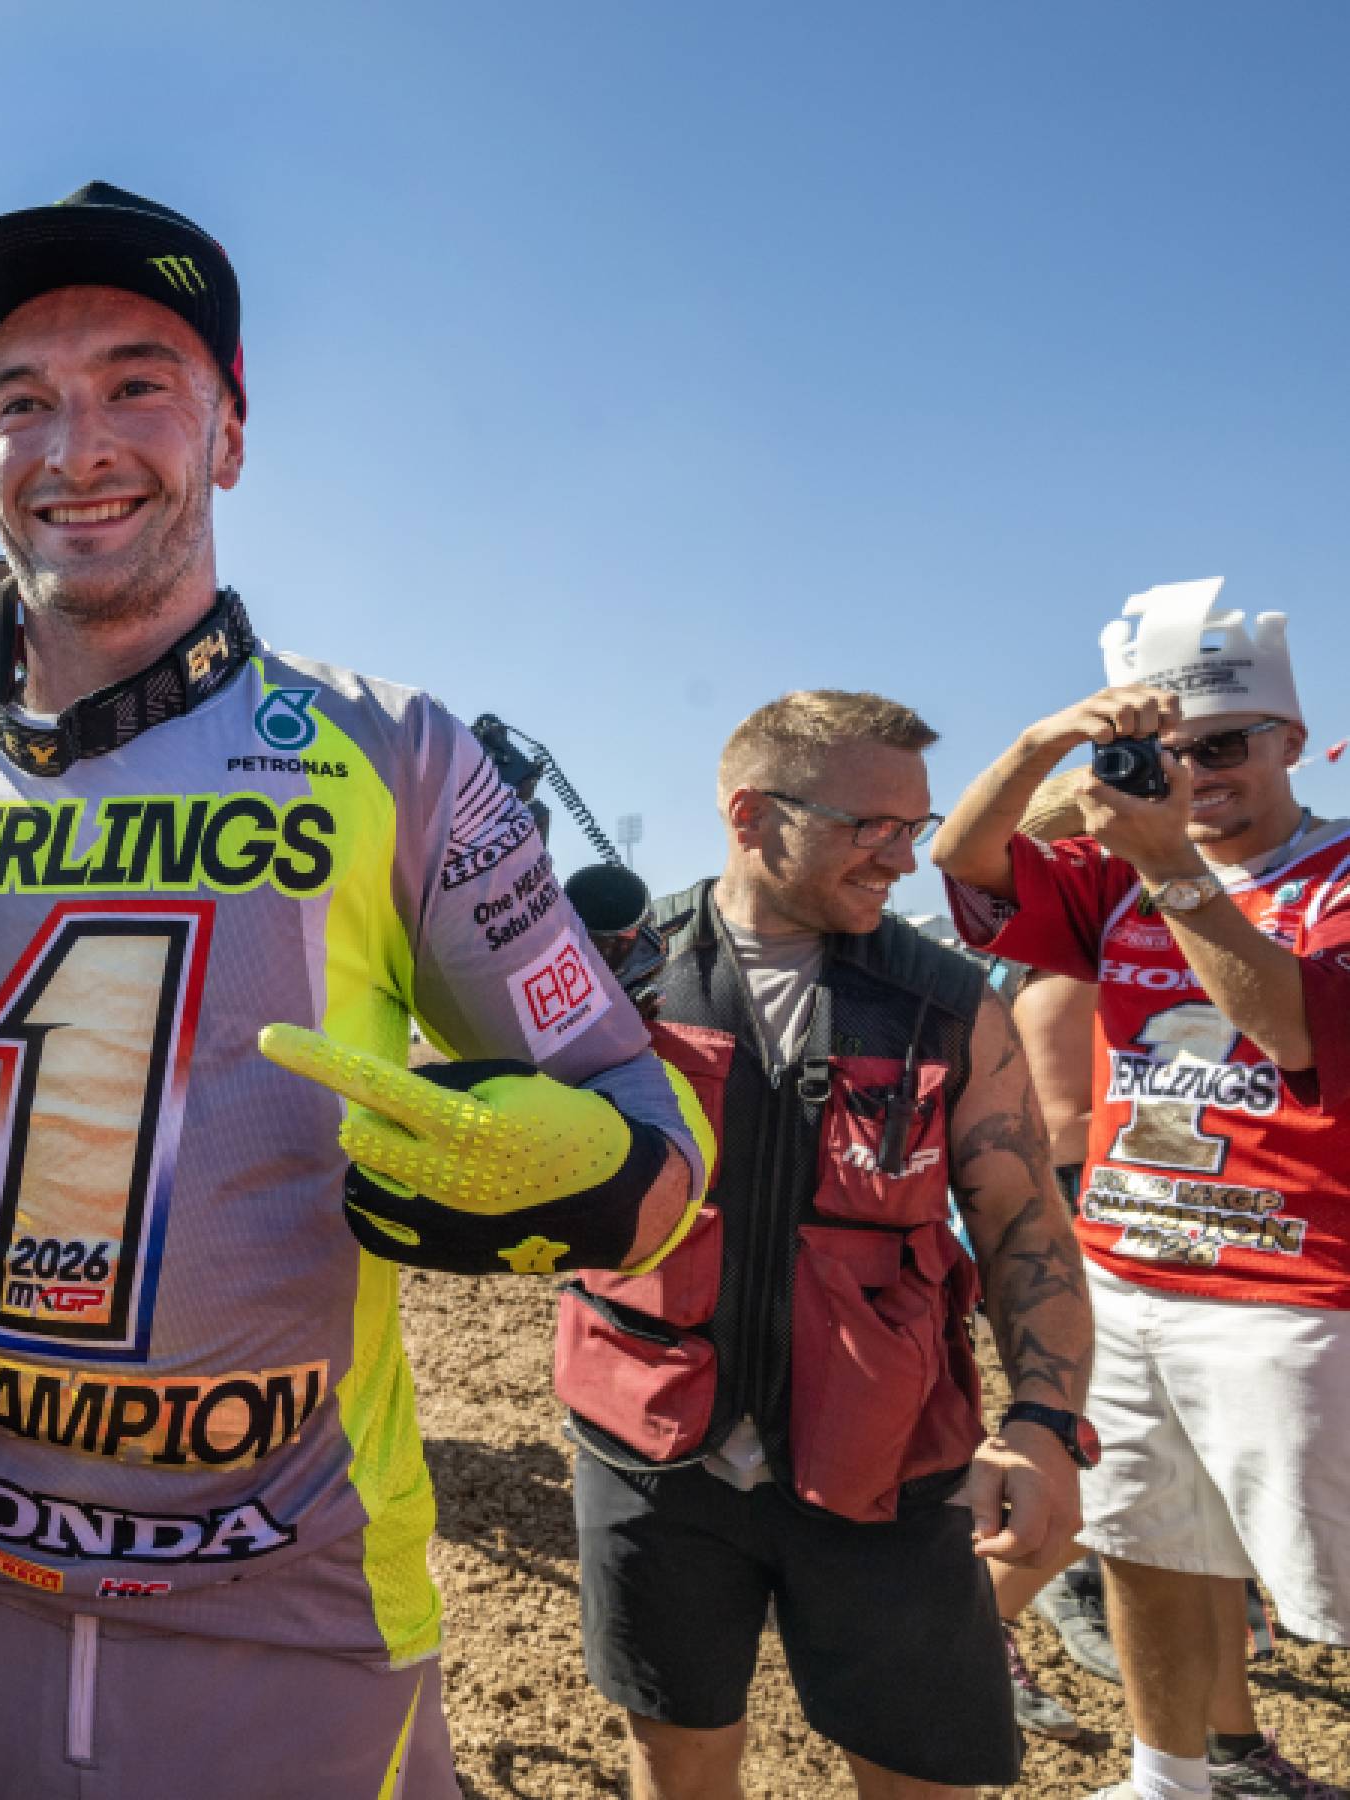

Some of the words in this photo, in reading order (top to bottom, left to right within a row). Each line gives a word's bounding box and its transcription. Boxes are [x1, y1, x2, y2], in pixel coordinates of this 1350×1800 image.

[226, 755, 348, 777] PETRONAS
[474, 889, 514, 926] One
[485, 909, 530, 952] Satu
[1109, 1051, 1279, 1111] ERLINGS
[12, 1238, 111, 1283] 2026
